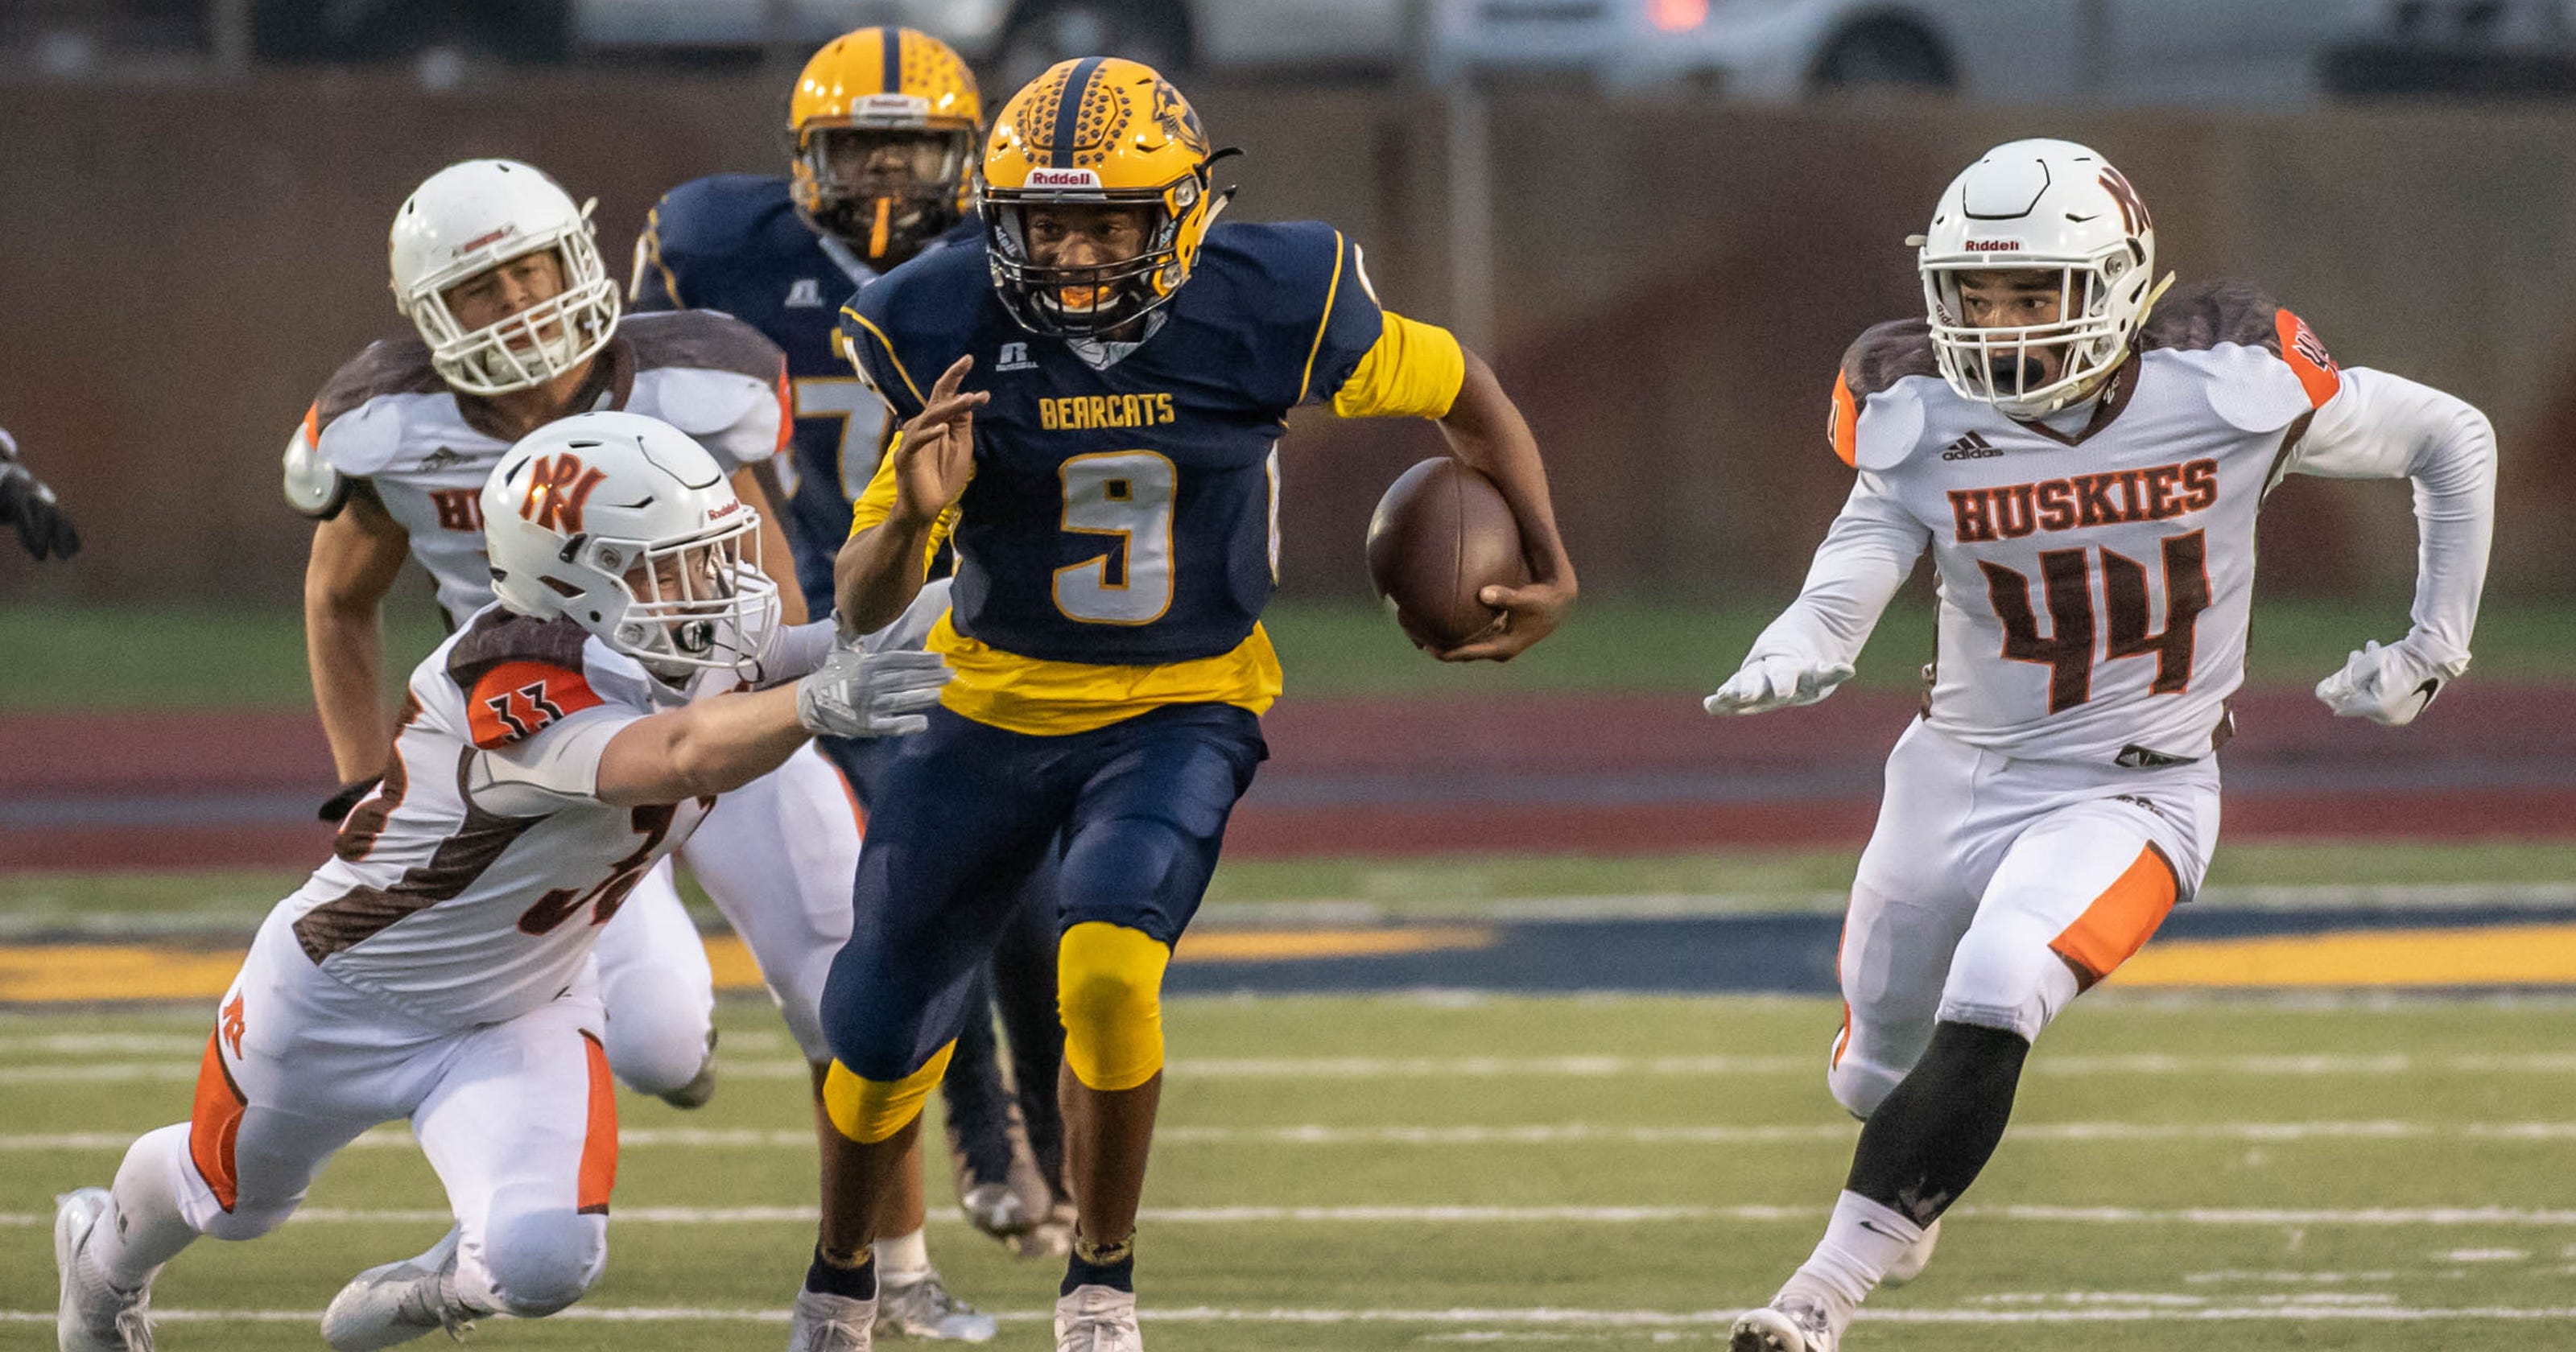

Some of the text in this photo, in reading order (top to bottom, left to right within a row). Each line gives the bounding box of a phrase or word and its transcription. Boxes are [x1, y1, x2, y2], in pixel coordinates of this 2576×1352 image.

[1032, 171, 1091, 186] Riddell
[1965, 240, 2020, 252] Riddell
[1038, 392, 1176, 431] BEARCATS
[1942, 447, 2004, 461] adidas
[1946, 457, 2219, 544] HUSKIES
[1052, 448, 1177, 626] 9
[1976, 526, 2213, 716] 44
